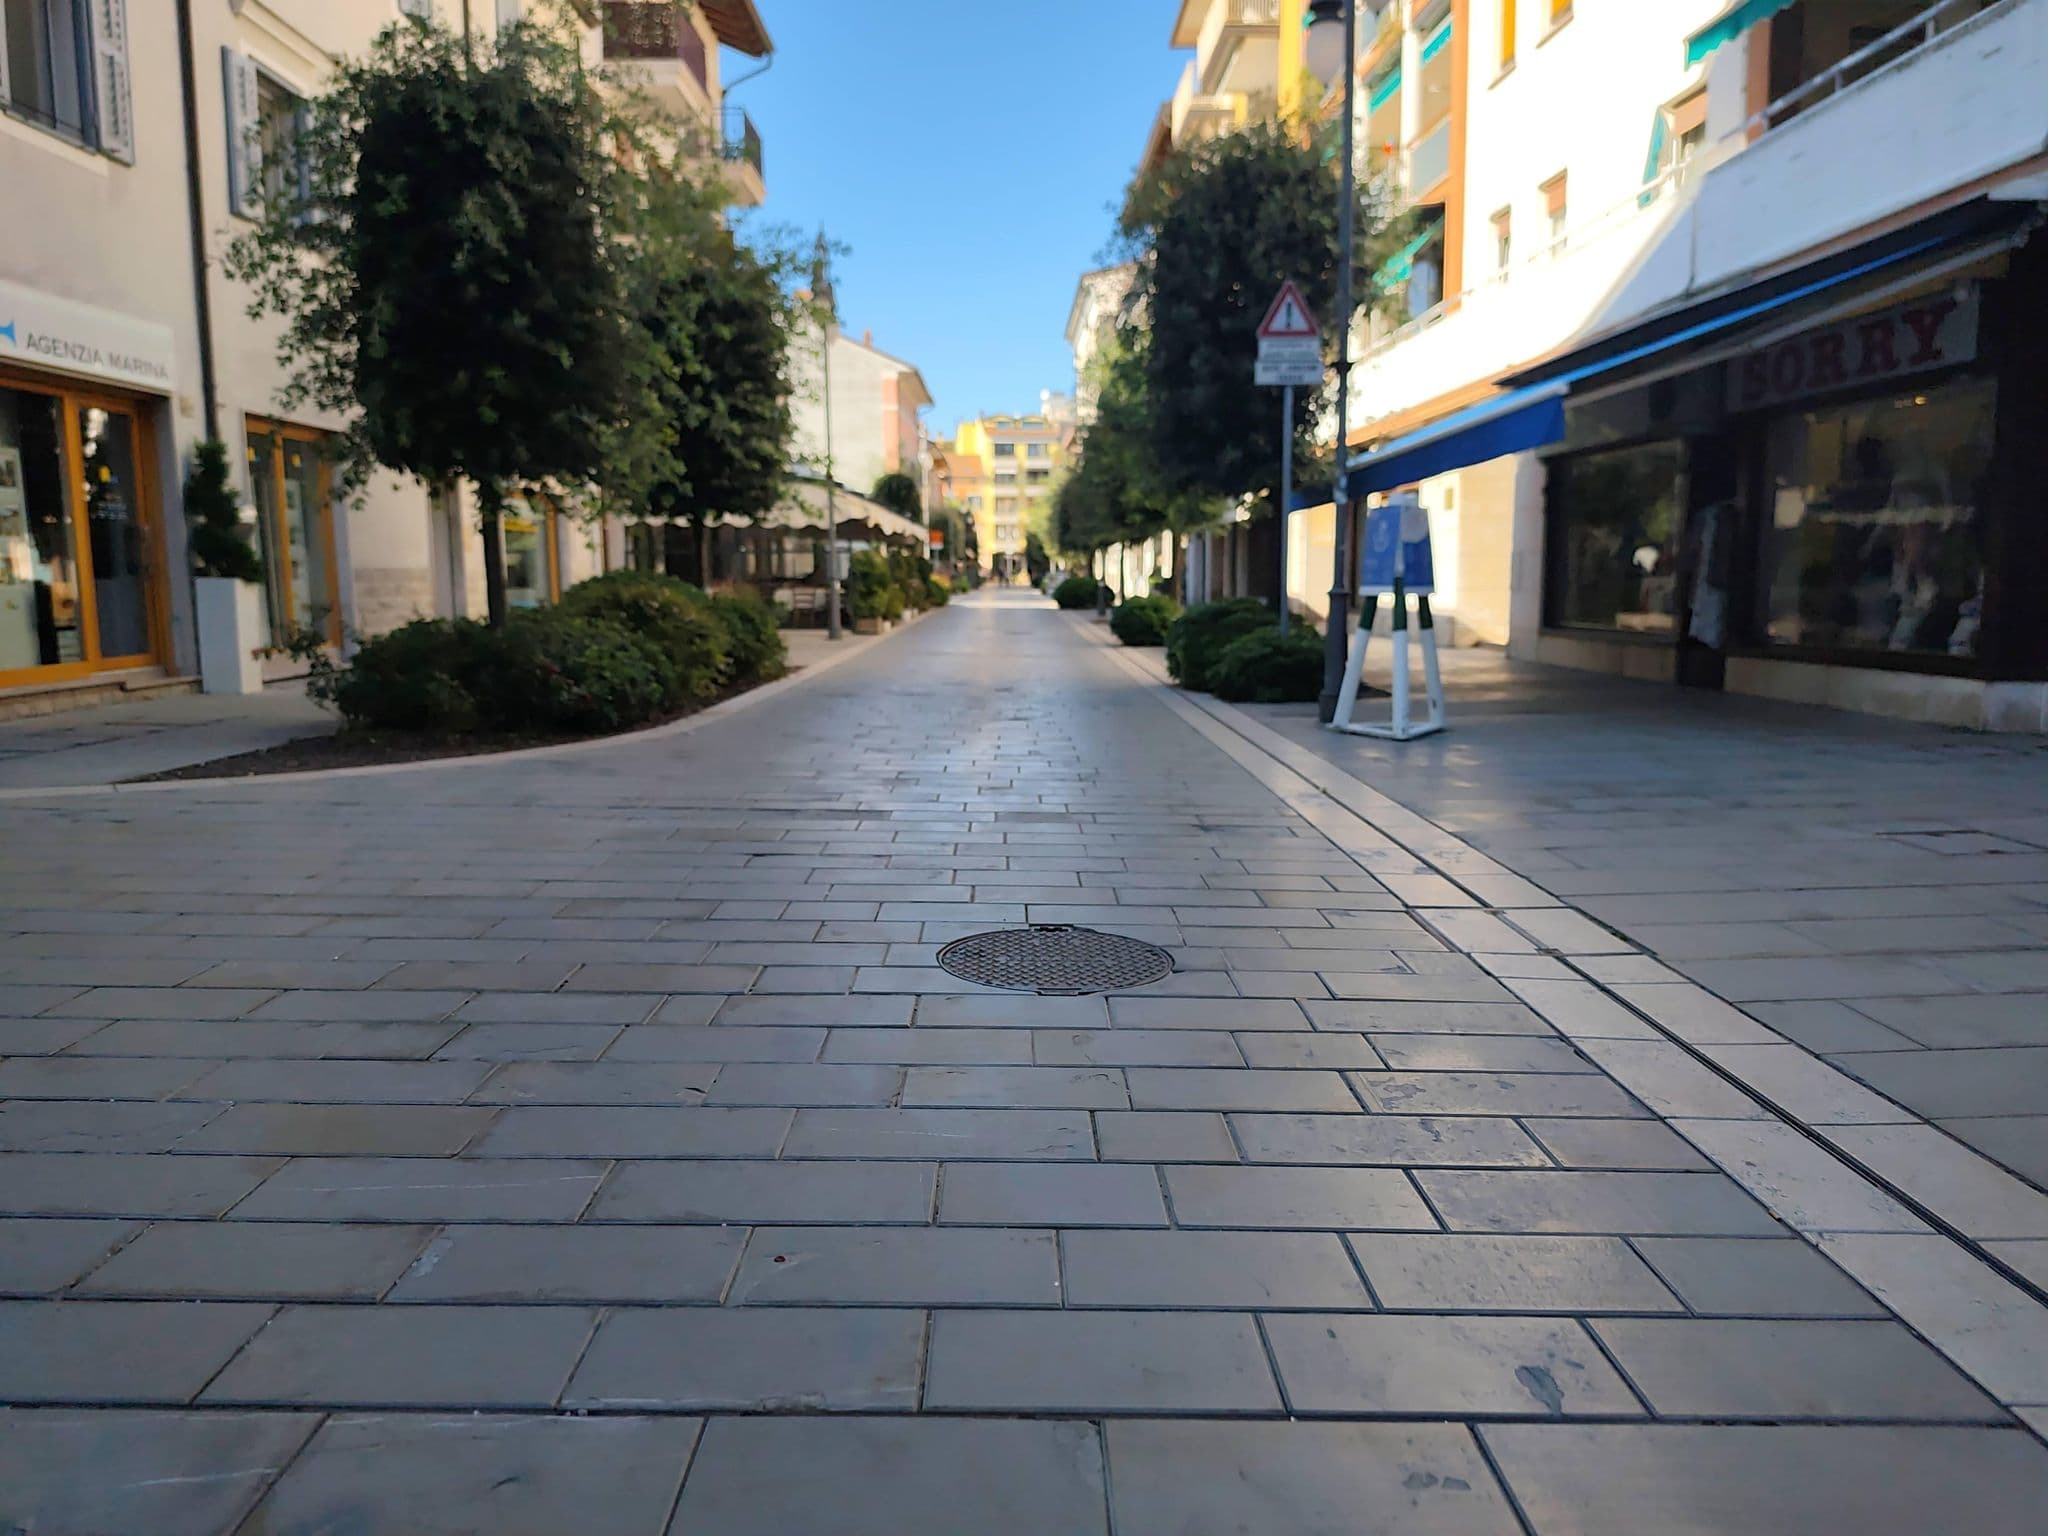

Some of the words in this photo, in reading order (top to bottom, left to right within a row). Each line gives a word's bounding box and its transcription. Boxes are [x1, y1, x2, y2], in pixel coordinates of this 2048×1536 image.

[26, 332, 104, 367] AGENZIA
[108, 351, 169, 380] MARINA
[1742, 298, 1957, 403] SORRY
